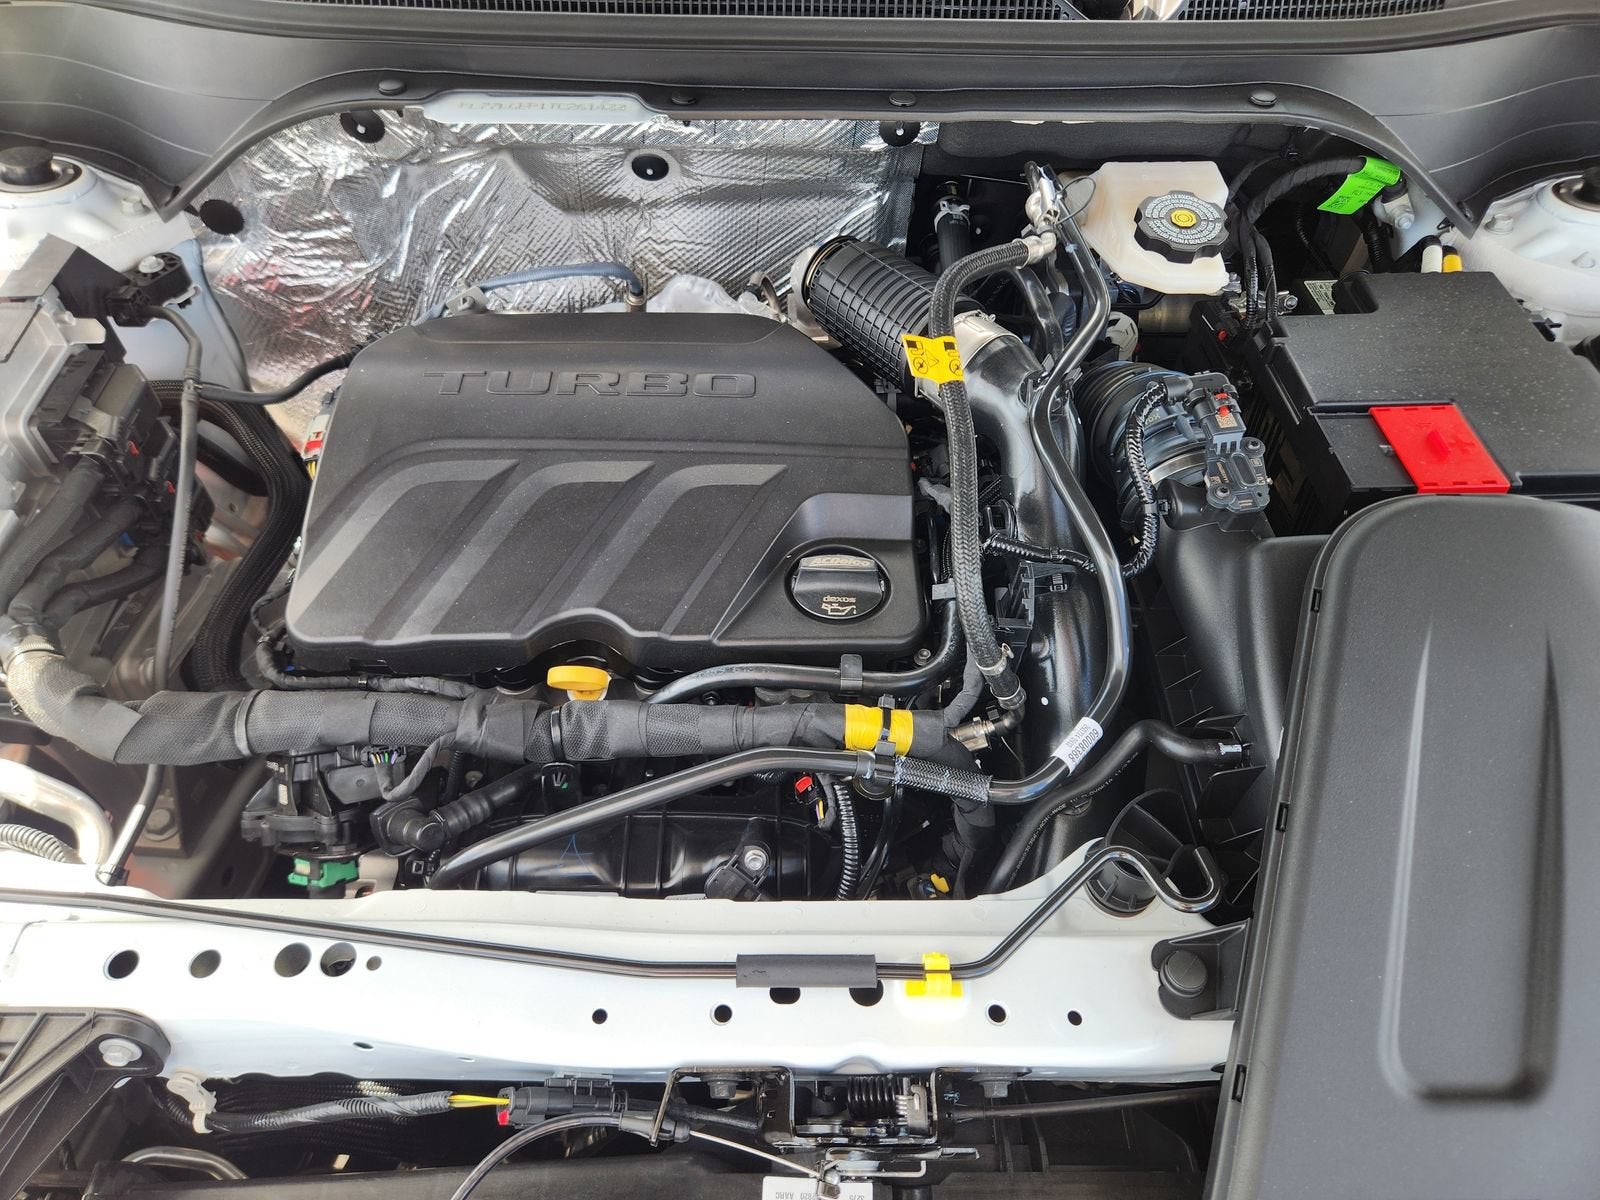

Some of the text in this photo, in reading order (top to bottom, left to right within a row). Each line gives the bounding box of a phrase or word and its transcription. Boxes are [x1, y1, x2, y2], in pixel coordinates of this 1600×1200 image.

[423, 371, 756, 397] TURBO
[808, 557, 871, 568] ACDelco
[822, 595, 856, 603] dexos
[1067, 728, 1100, 763] 60008388
